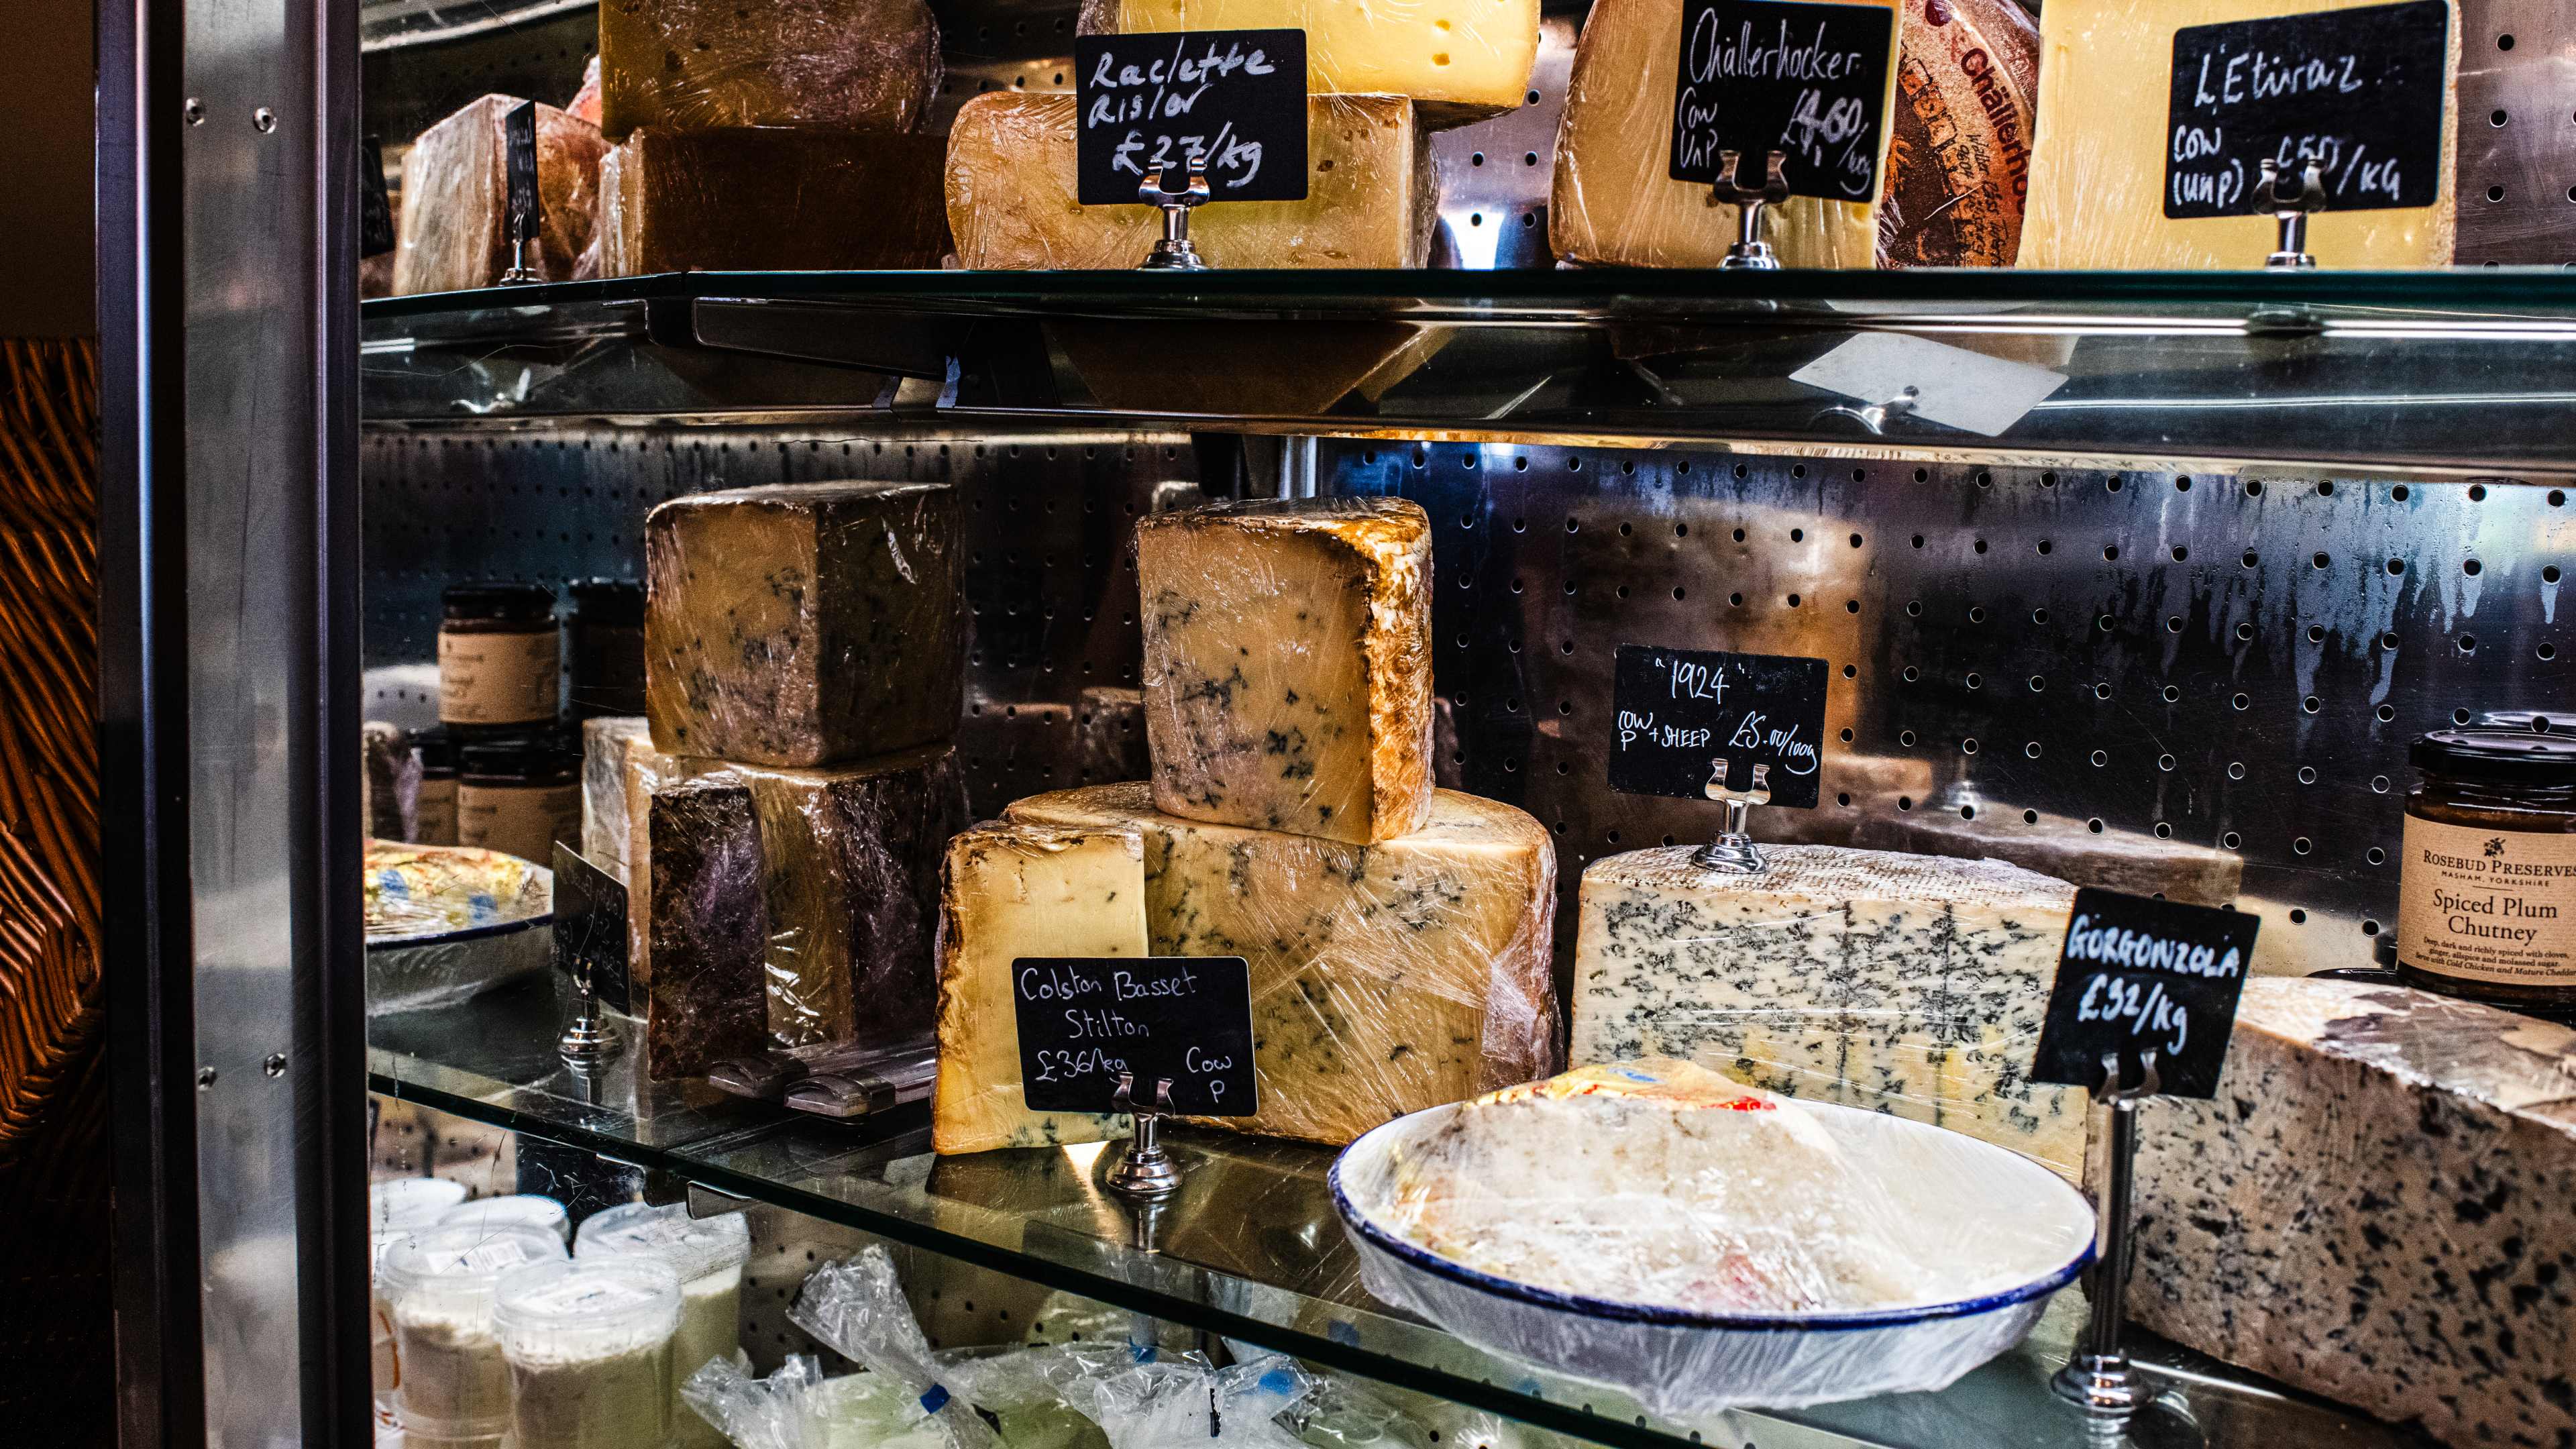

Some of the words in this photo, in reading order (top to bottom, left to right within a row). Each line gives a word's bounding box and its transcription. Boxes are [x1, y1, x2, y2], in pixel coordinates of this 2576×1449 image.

[1089, 36, 1276, 89] Raclette
[1661, 724, 1711, 748] SHEEP
[2489, 876, 2549, 888] YORKSHIRE
[2433, 888, 2493, 914] Spiced
[2503, 896, 2557, 918] Plum
[2449, 915, 2537, 947] Chutney
[2067, 914, 2239, 977] GORGONZOLA
[2441, 941, 2457, 950] dark
[2458, 944, 2472, 952] and
[2473, 946, 2497, 957] richly
[2498, 948, 2524, 958] spiced
[2525, 950, 2543, 958] with
[2453, 951, 2481, 962] allspice
[2482, 955, 2497, 963] and
[2431, 955, 2445, 965] with
[2447, 959, 2463, 969] Cold
[2464, 961, 2495, 973] Chicken
[2496, 966, 2513, 975] and
[2515, 967, 2544, 977] Mature
[1020, 965, 1102, 1001] Colston
[1114, 966, 1197, 1002] Basset
[1065, 1008, 1149, 1038] Stilton
[1186, 1046, 1232, 1073] Cow
